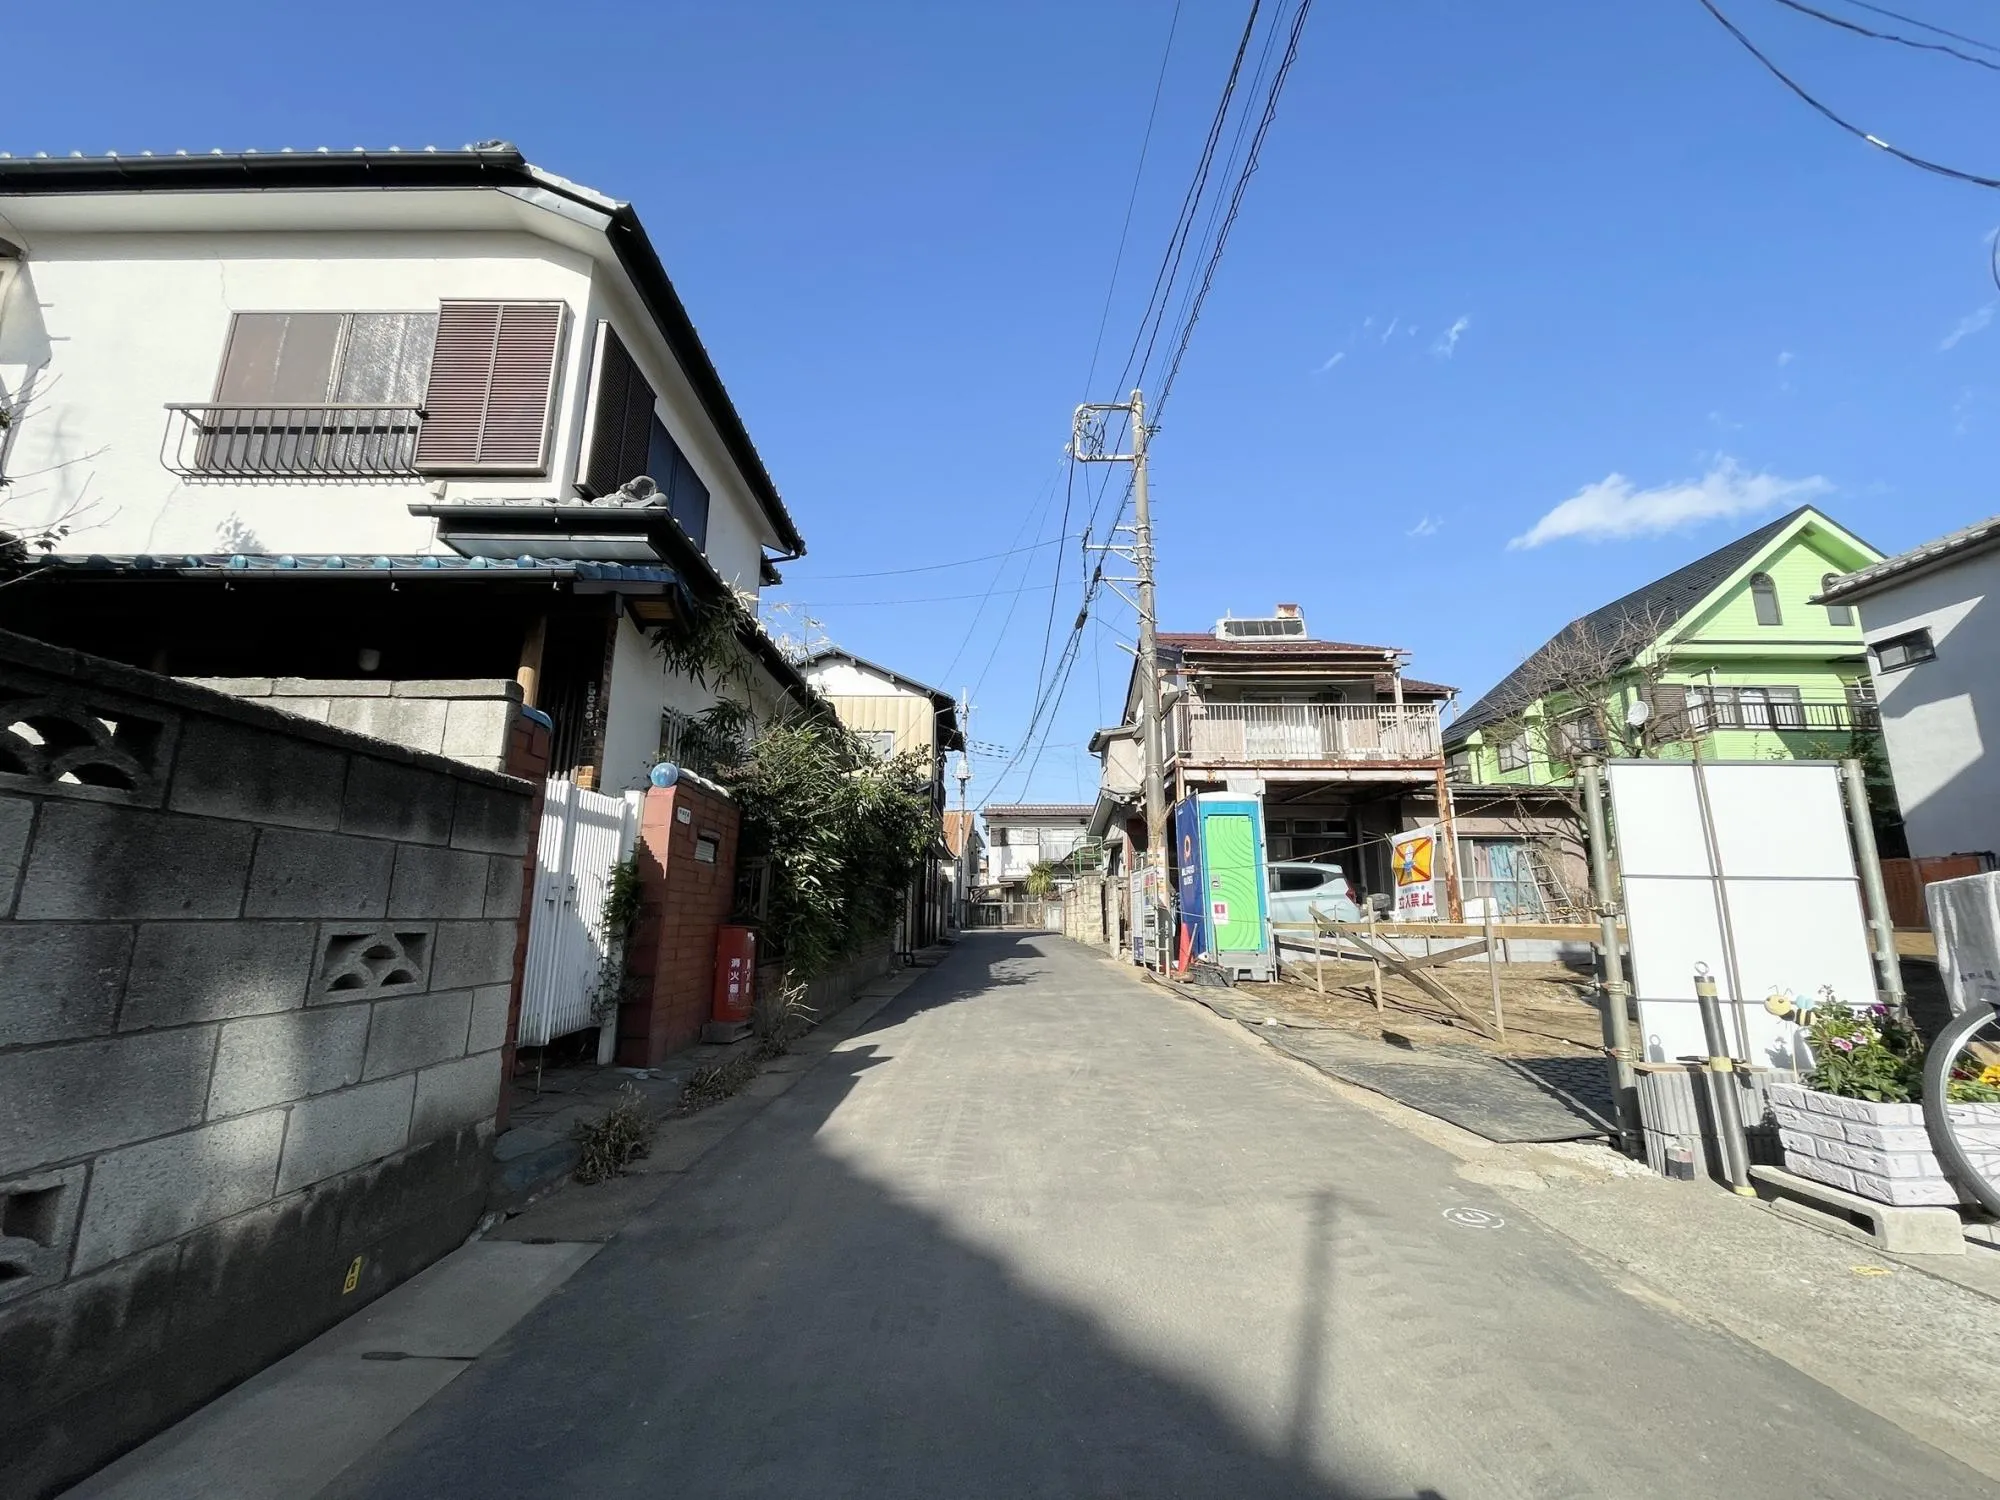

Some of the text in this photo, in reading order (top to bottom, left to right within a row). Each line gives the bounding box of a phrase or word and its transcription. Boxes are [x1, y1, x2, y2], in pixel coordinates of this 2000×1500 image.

[1399, 892, 1433, 909] 立入禁止
[730, 958, 741, 993] 消火器
